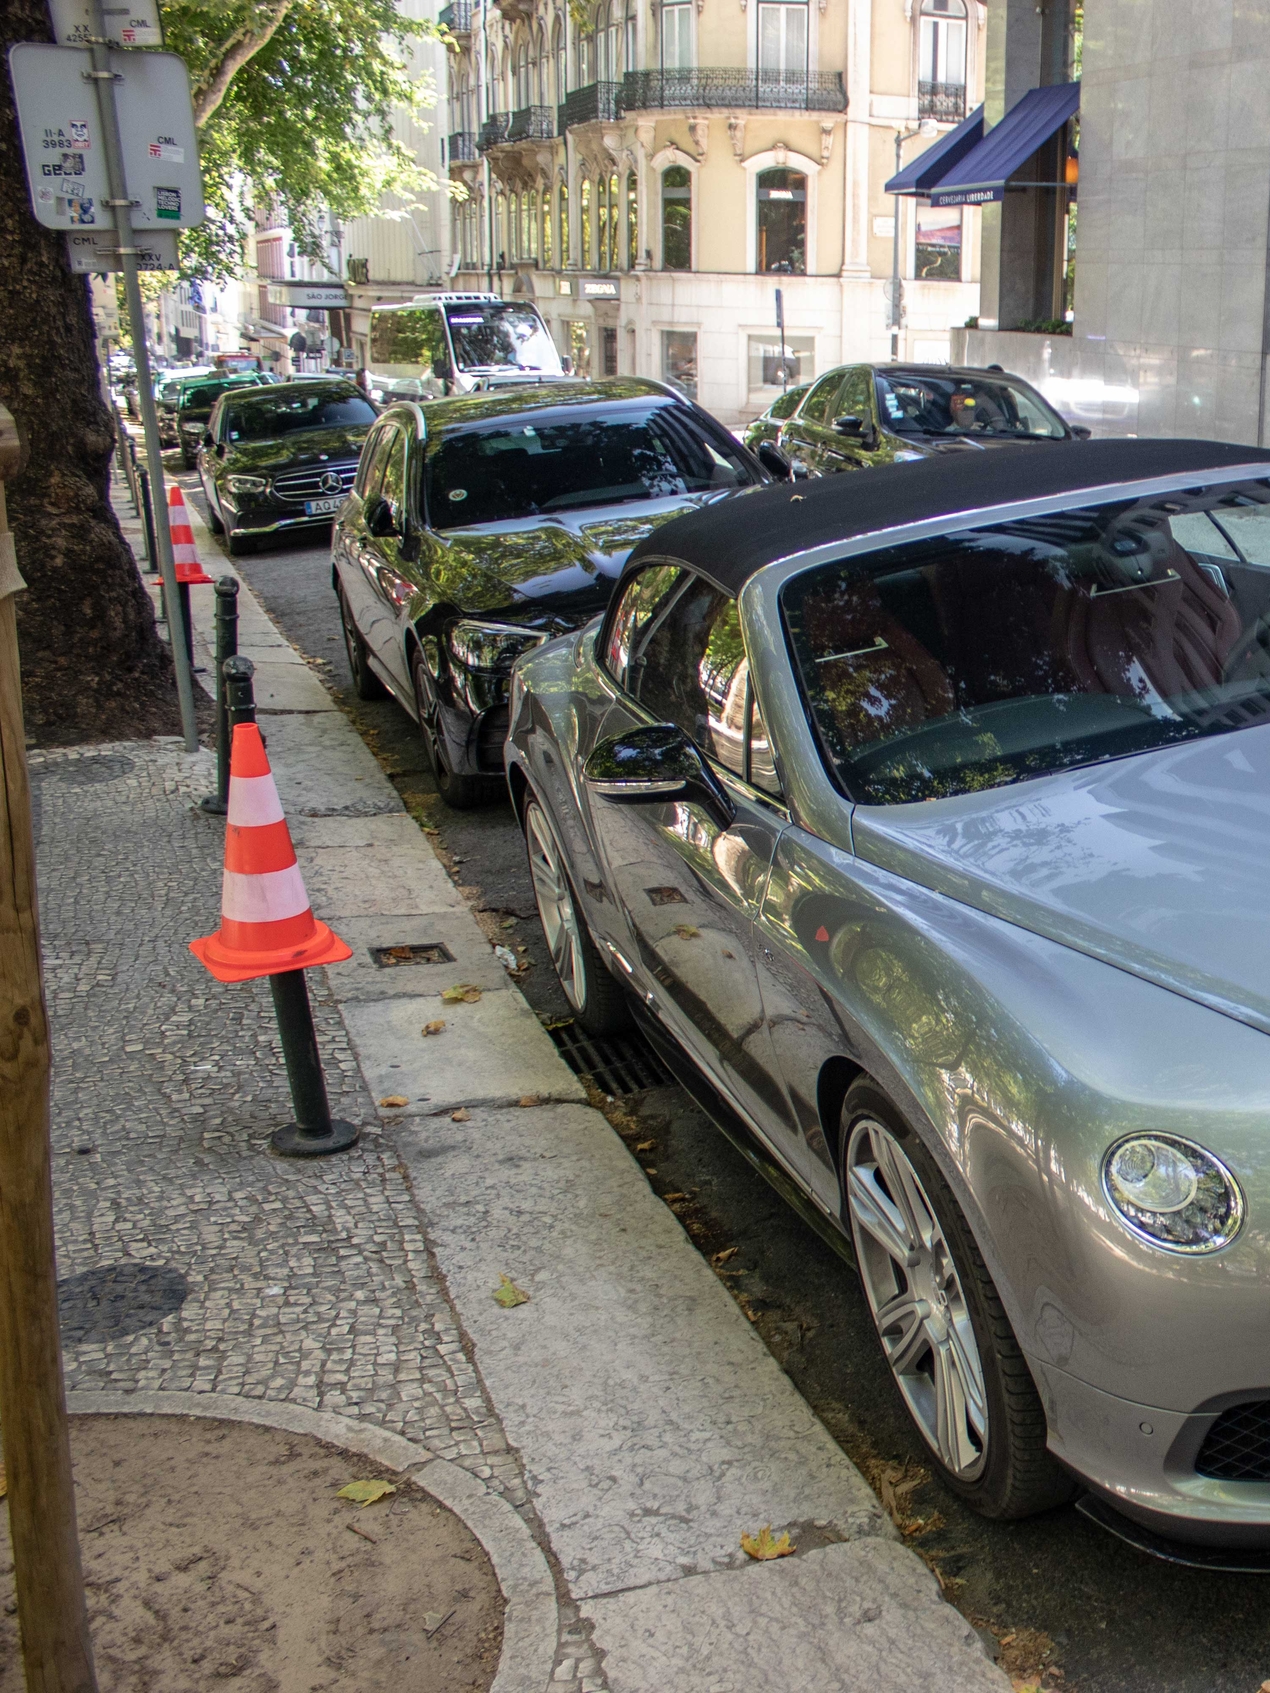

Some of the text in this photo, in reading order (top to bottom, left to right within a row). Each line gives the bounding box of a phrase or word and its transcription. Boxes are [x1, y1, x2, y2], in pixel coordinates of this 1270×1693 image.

[129, 20, 151, 28] CML
[43, 140, 72, 149] 3983
[157, 136, 177, 146] CML
[939, 191, 994, 204] CERVEJARIA LIBERDADE
[73, 237, 99, 245] CML
